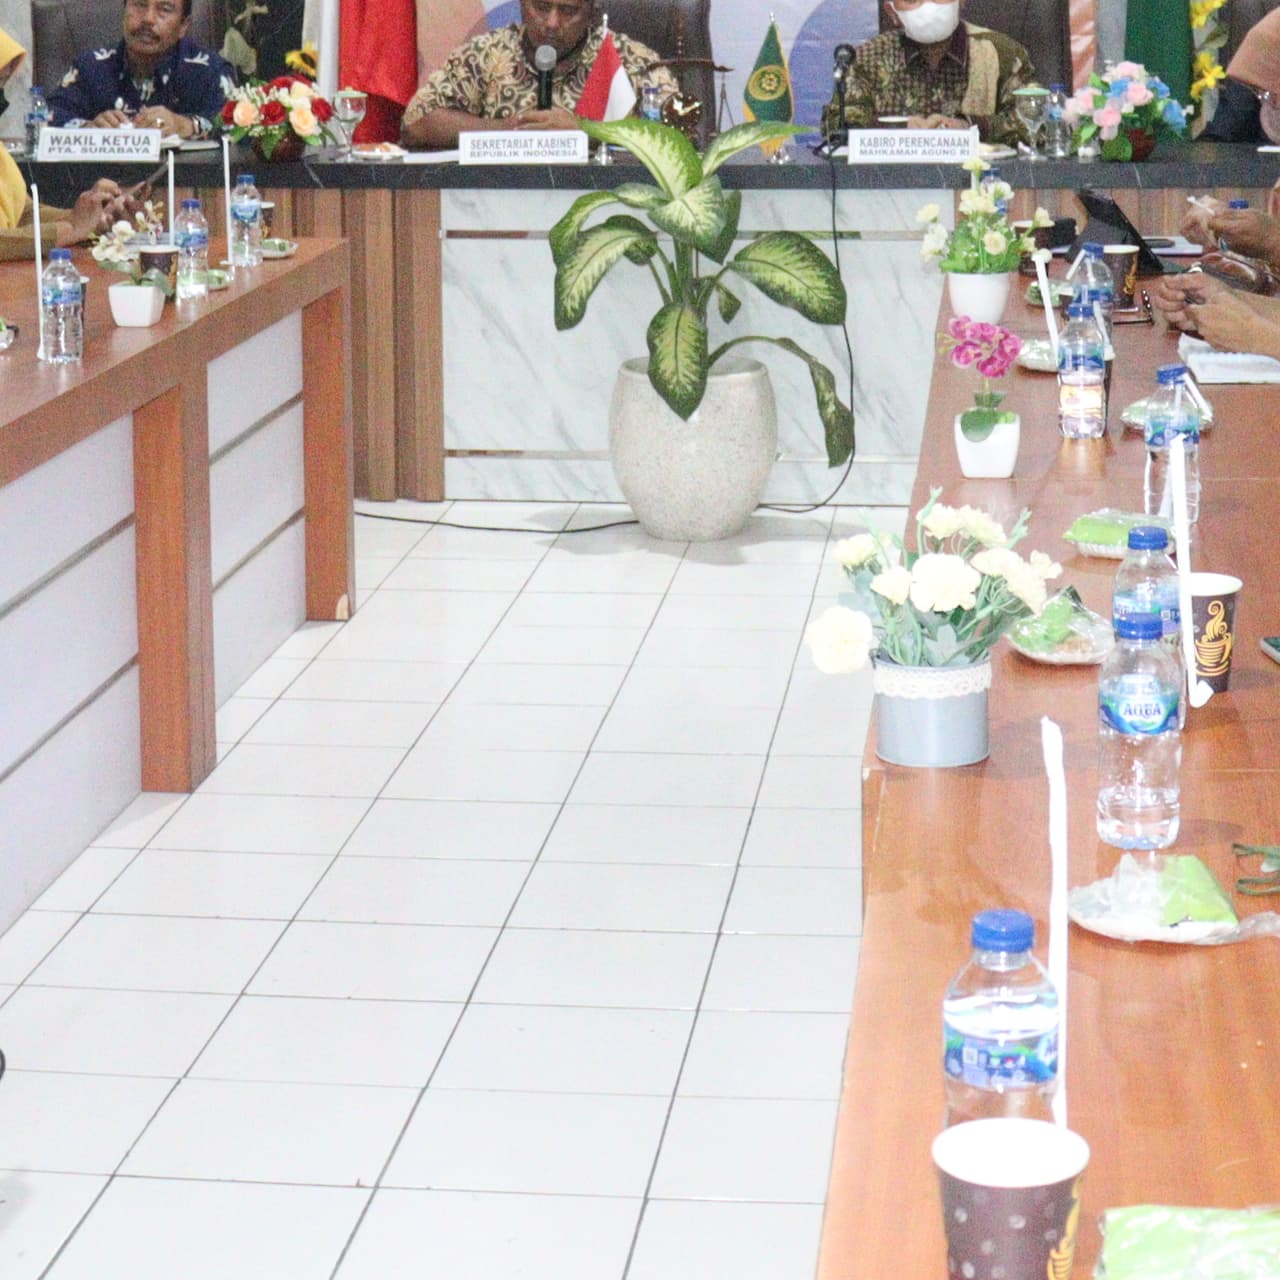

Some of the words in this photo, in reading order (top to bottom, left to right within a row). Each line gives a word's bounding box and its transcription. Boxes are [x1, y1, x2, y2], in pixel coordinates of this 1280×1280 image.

[50, 135, 96, 146] WAKIL
[102, 135, 151, 146] KETUA
[470, 138, 533, 150] SEKRETARIAT
[537, 137, 578, 148] KABINET
[859, 137, 896, 148] KABIRO
[898, 137, 969, 148] PERENCANAAN
[470, 150, 519, 158] REPUBLIK
[523, 148, 578, 157] INDONESIA
[1124, 702, 1161, 718] AQUA
